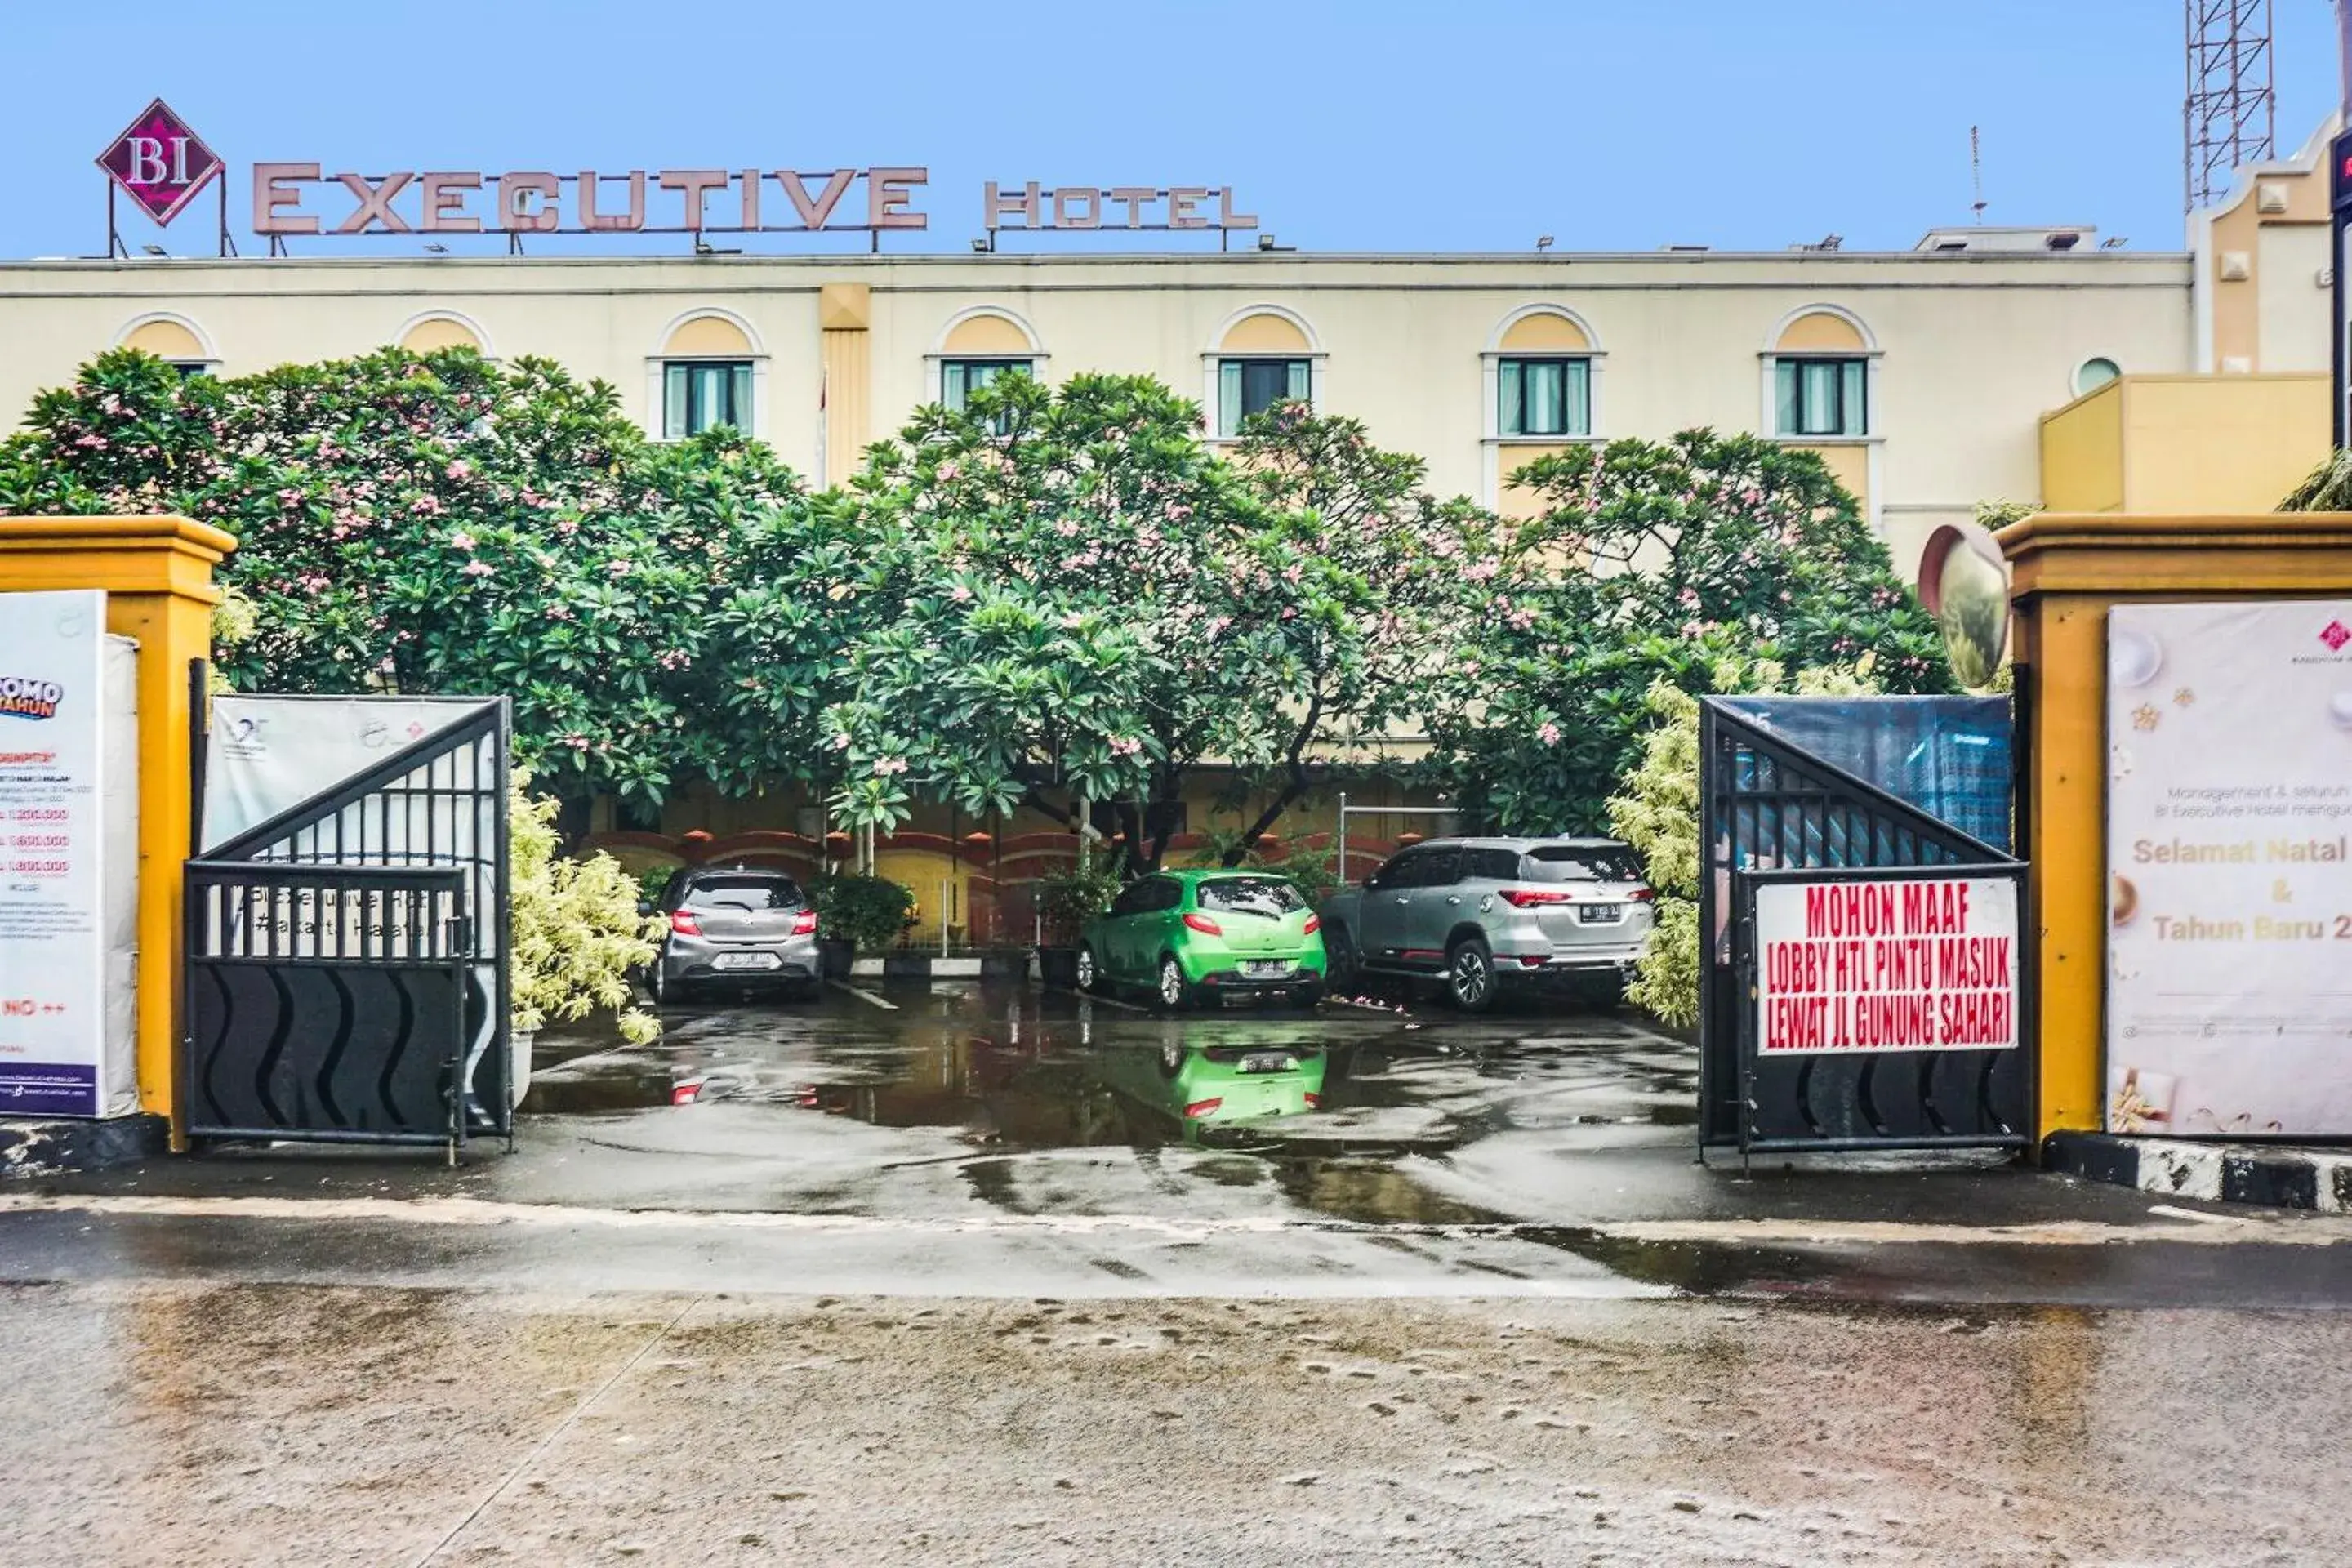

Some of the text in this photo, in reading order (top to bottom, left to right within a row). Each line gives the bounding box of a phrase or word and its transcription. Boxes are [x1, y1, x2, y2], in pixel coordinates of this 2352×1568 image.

[126, 136, 193, 185] BI
[252, 162, 1258, 234] EXECUTIVE HOTEL
[0, 676, 63, 704] OMO
[2292, 805, 2352, 821] mengu
[2132, 836, 2346, 864] Selamat Natal
[2271, 877, 2293, 903] &
[1805, 882, 1970, 938] MOHON MAAF
[2152, 915, 2245, 941] Tahun
[2254, 915, 2324, 940] Baru
[1766, 935, 2010, 994] LOBBY HTL PINTU MASUK
[1766, 991, 2012, 1049] LEWAT JL GUNUNG SAHARI
